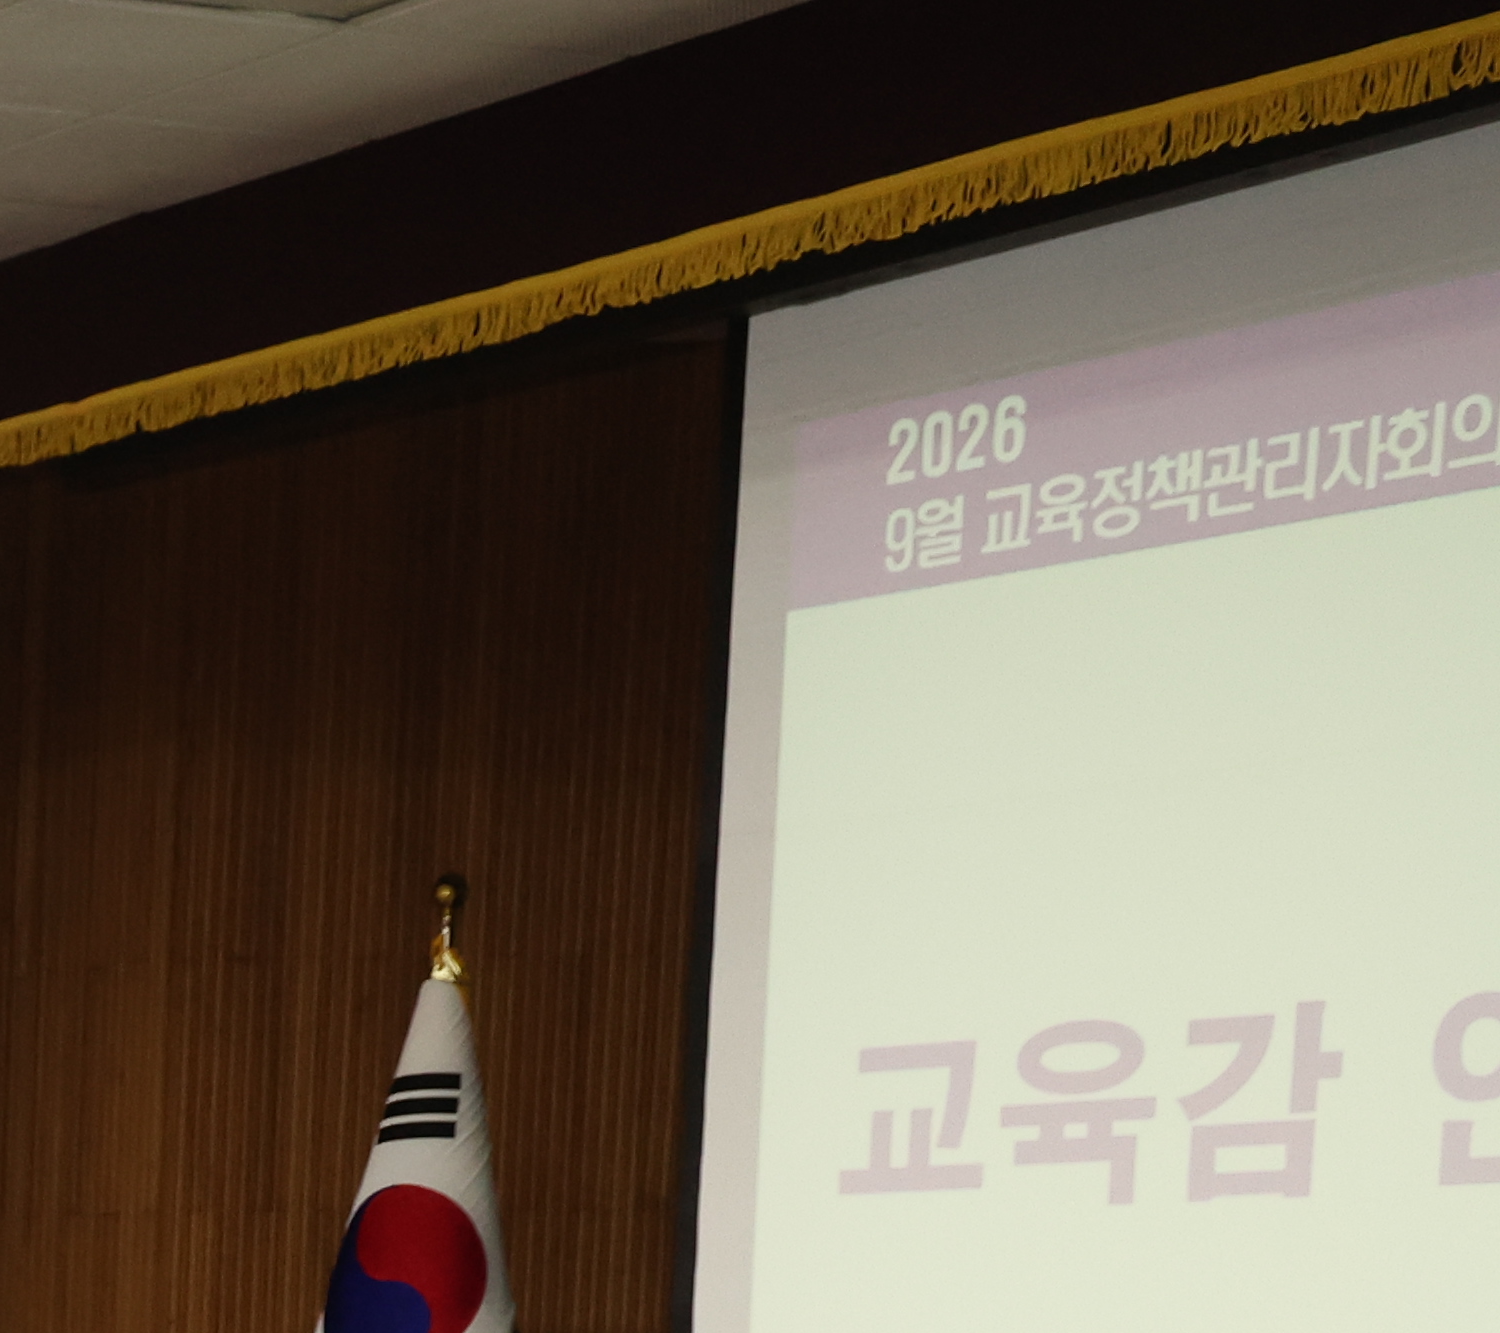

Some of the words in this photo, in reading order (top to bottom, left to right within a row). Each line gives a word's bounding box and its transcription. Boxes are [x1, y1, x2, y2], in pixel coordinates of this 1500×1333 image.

[884, 494, 966, 573] 9월
[980, 394, 1500, 554] 교육정책관리자회의
[886, 395, 1028, 486] 2026
[838, 999, 1344, 1206] 교육감
